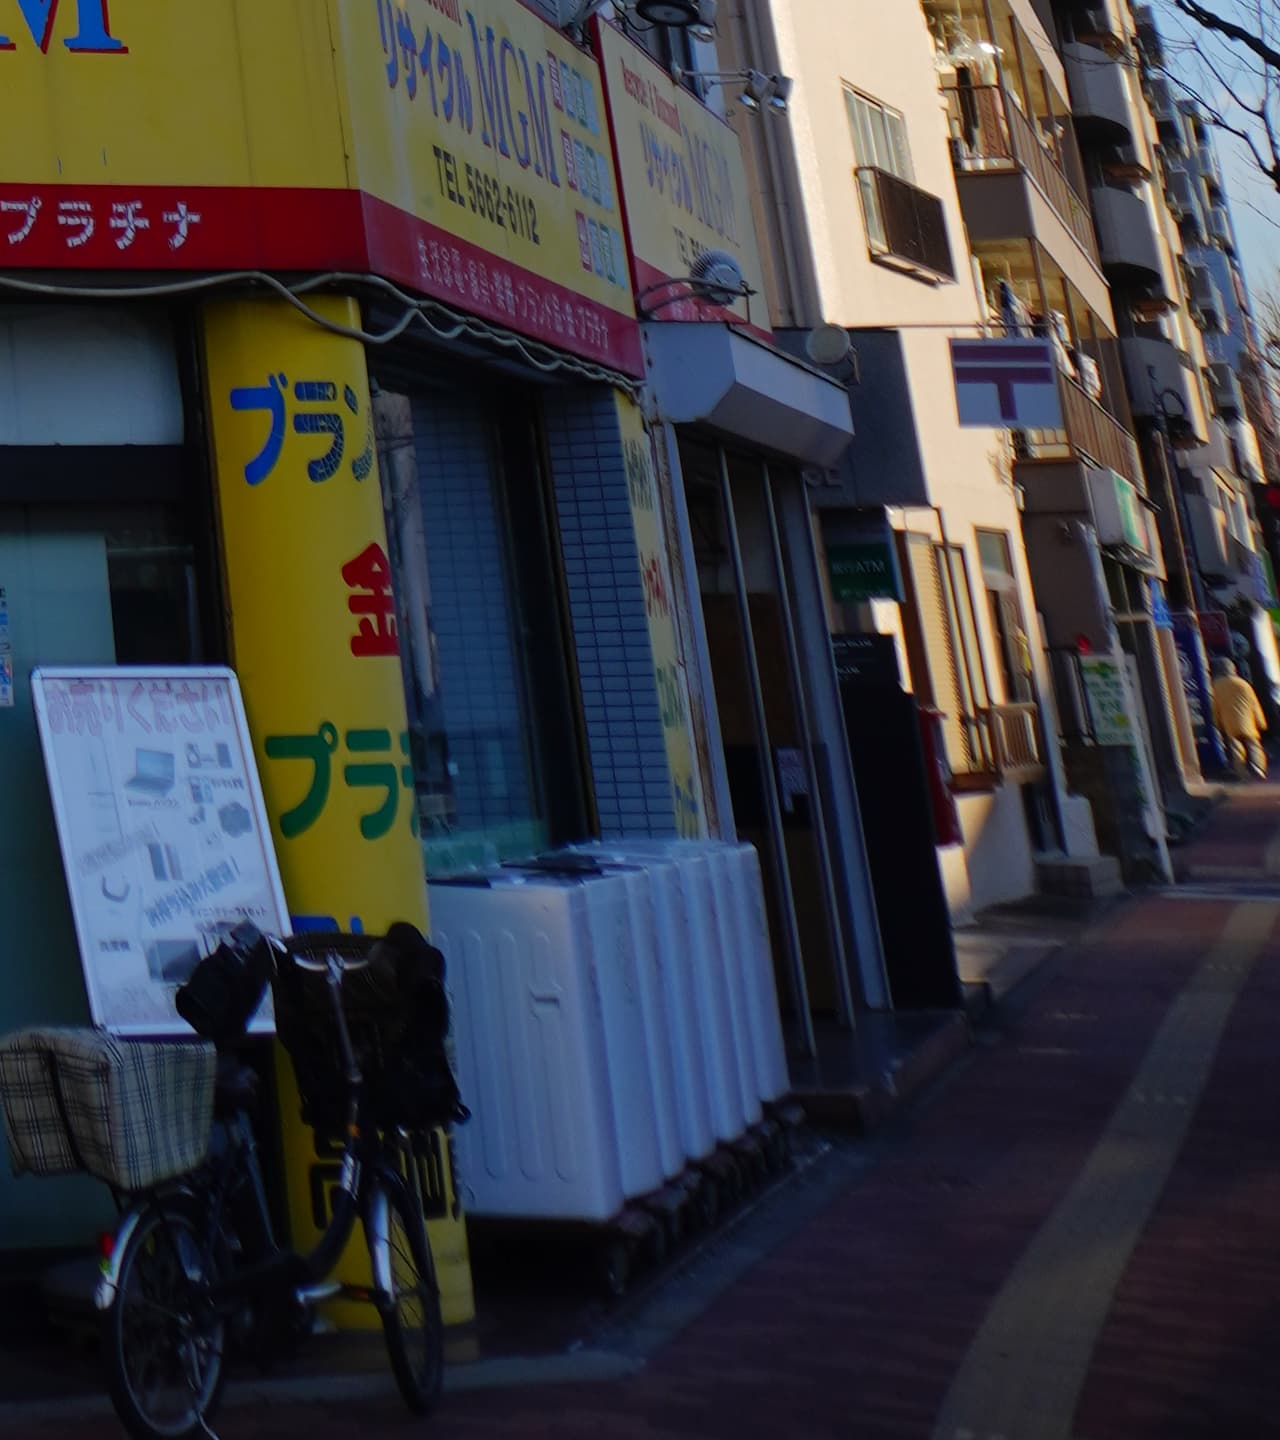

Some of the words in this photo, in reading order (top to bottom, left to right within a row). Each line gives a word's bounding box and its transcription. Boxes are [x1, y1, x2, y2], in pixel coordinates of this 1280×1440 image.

[465, 8, 561, 188] MGM
[432, 144, 466, 209] TEL
[465, 161, 541, 246] 5662-6112
[342, 542, 401, 657] 金
